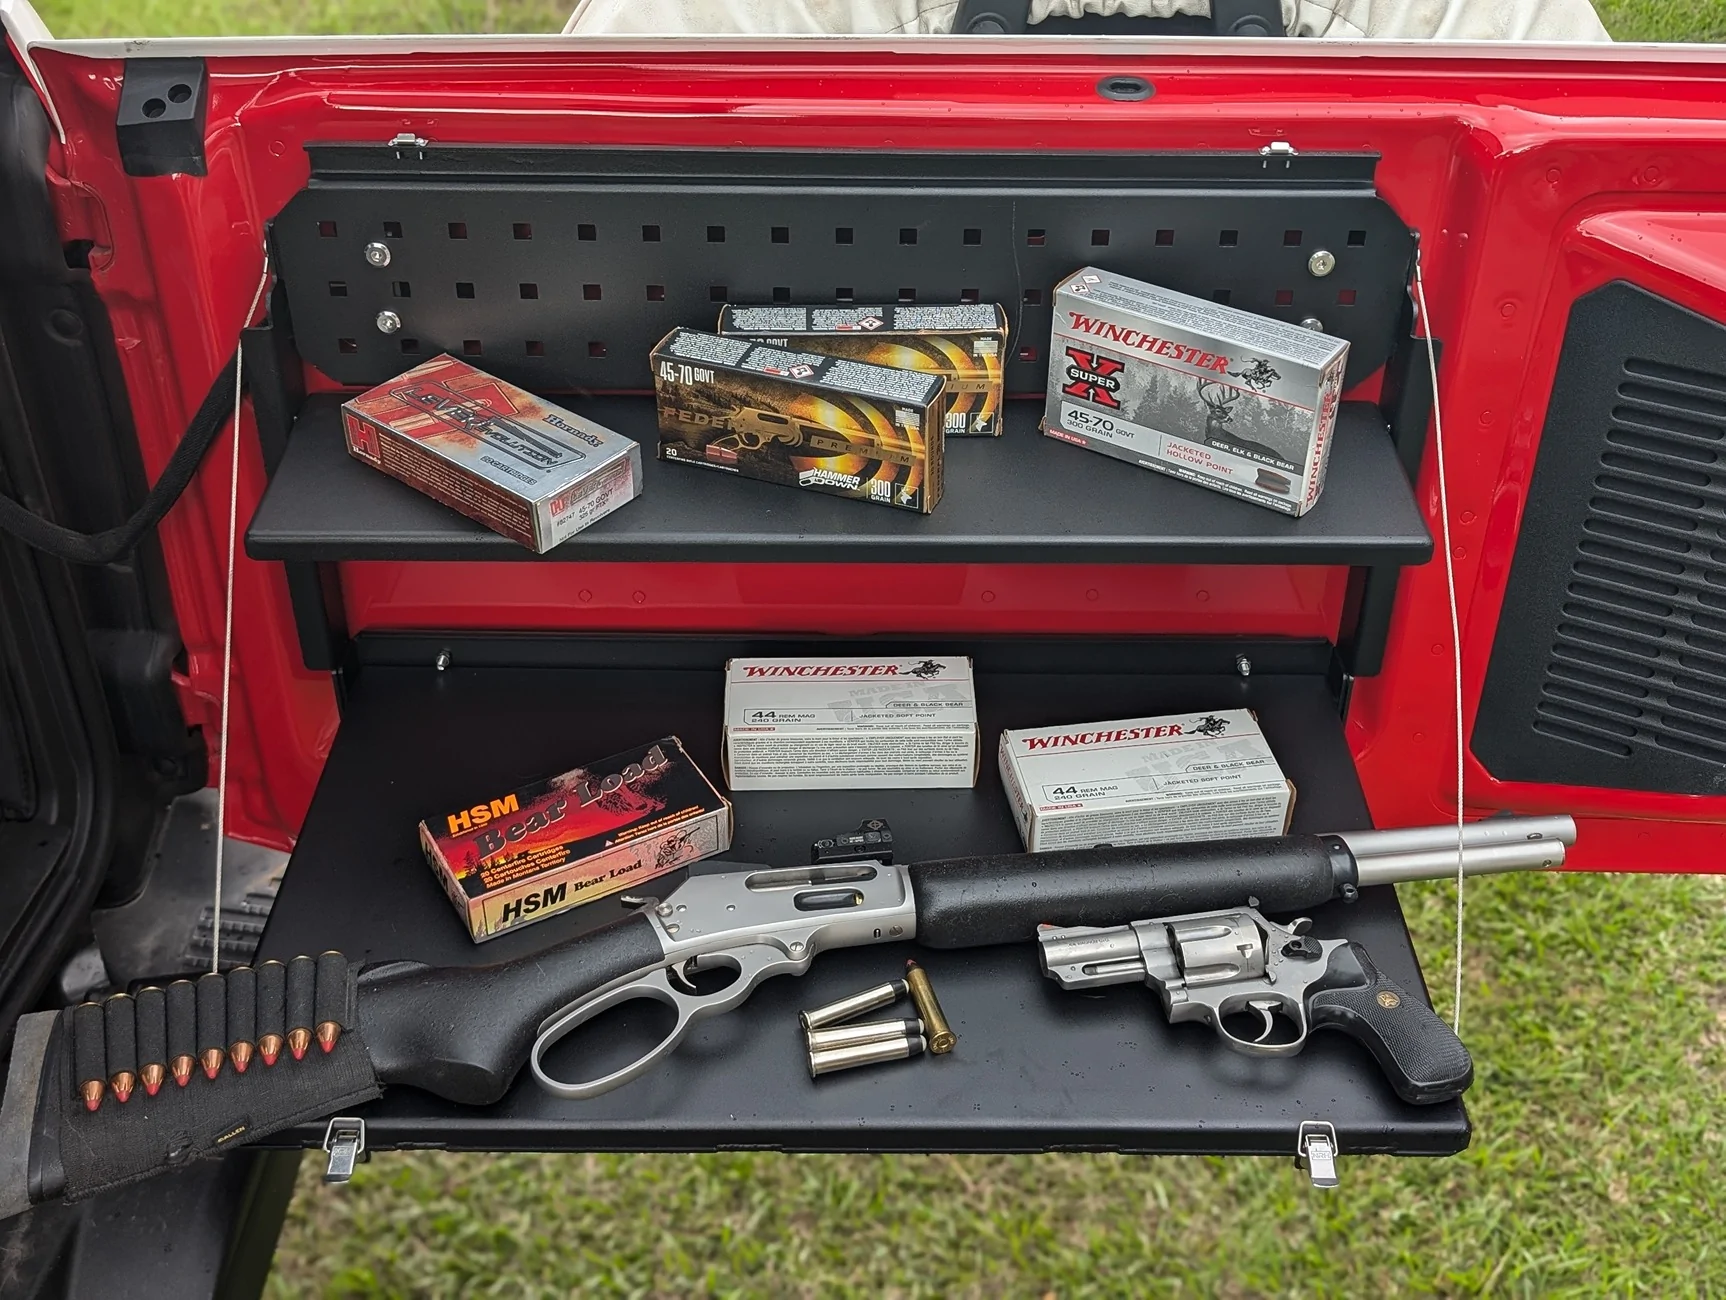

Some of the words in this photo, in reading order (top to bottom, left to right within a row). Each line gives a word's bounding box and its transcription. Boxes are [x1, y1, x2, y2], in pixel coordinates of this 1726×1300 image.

[1069, 312, 1230, 374] WINCHESTER
[660, 361, 693, 386] 45-70
[694, 368, 715, 384] GOVT
[1070, 369, 1116, 389] SUPER
[663, 406, 734, 429] FEDE
[945, 412, 966, 428] 300
[1067, 419, 1083, 429] 300
[1085, 425, 1113, 438] GRAIN
[1068, 409, 1113, 431] 45-70
[1116, 428, 1135, 439] GOVT
[542, 414, 603, 447] Hornady
[1049, 429, 1064, 437] MADE
[666, 447, 677, 456] 20
[1166, 442, 1212, 460] JACKETED
[1166, 449, 1204, 465] HOLLOW
[1206, 461, 1234, 475] POINT
[1211, 440, 1229, 451] DEER,
[1232, 447, 1245, 455] ELK
[1253, 454, 1275, 465] BLACK
[1276, 460, 1295, 470] BEAR
[813, 468, 860, 485] HAMMER
[871, 478, 890, 497] 300
[595, 488, 613, 503] GOVT
[871, 495, 890, 503] GRAIN
[743, 664, 899, 677] WINCHESTER
[1022, 724, 1183, 750] WINCHESTER
[1052, 786, 1077, 795] 44
[1163, 778, 1199, 786] JACKETED
[1075, 791, 1106, 799] GRAIN
[447, 794, 519, 834] HSM
[473, 800, 567, 861] Bear
[573, 744, 668, 808] Load
[483, 876, 493, 884] 20
[493, 862, 535, 881] Cartouches
[535, 849, 571, 864] Centerfire
[490, 856, 526, 875] Centerfire
[527, 845, 564, 861] Cartridges
[486, 880, 504, 889] Made
[512, 867, 540, 879] Montana
[541, 857, 566, 869] Territory
[502, 882, 567, 923] HSM
[574, 874, 607, 892] Bear
[609, 860, 642, 879] Load
